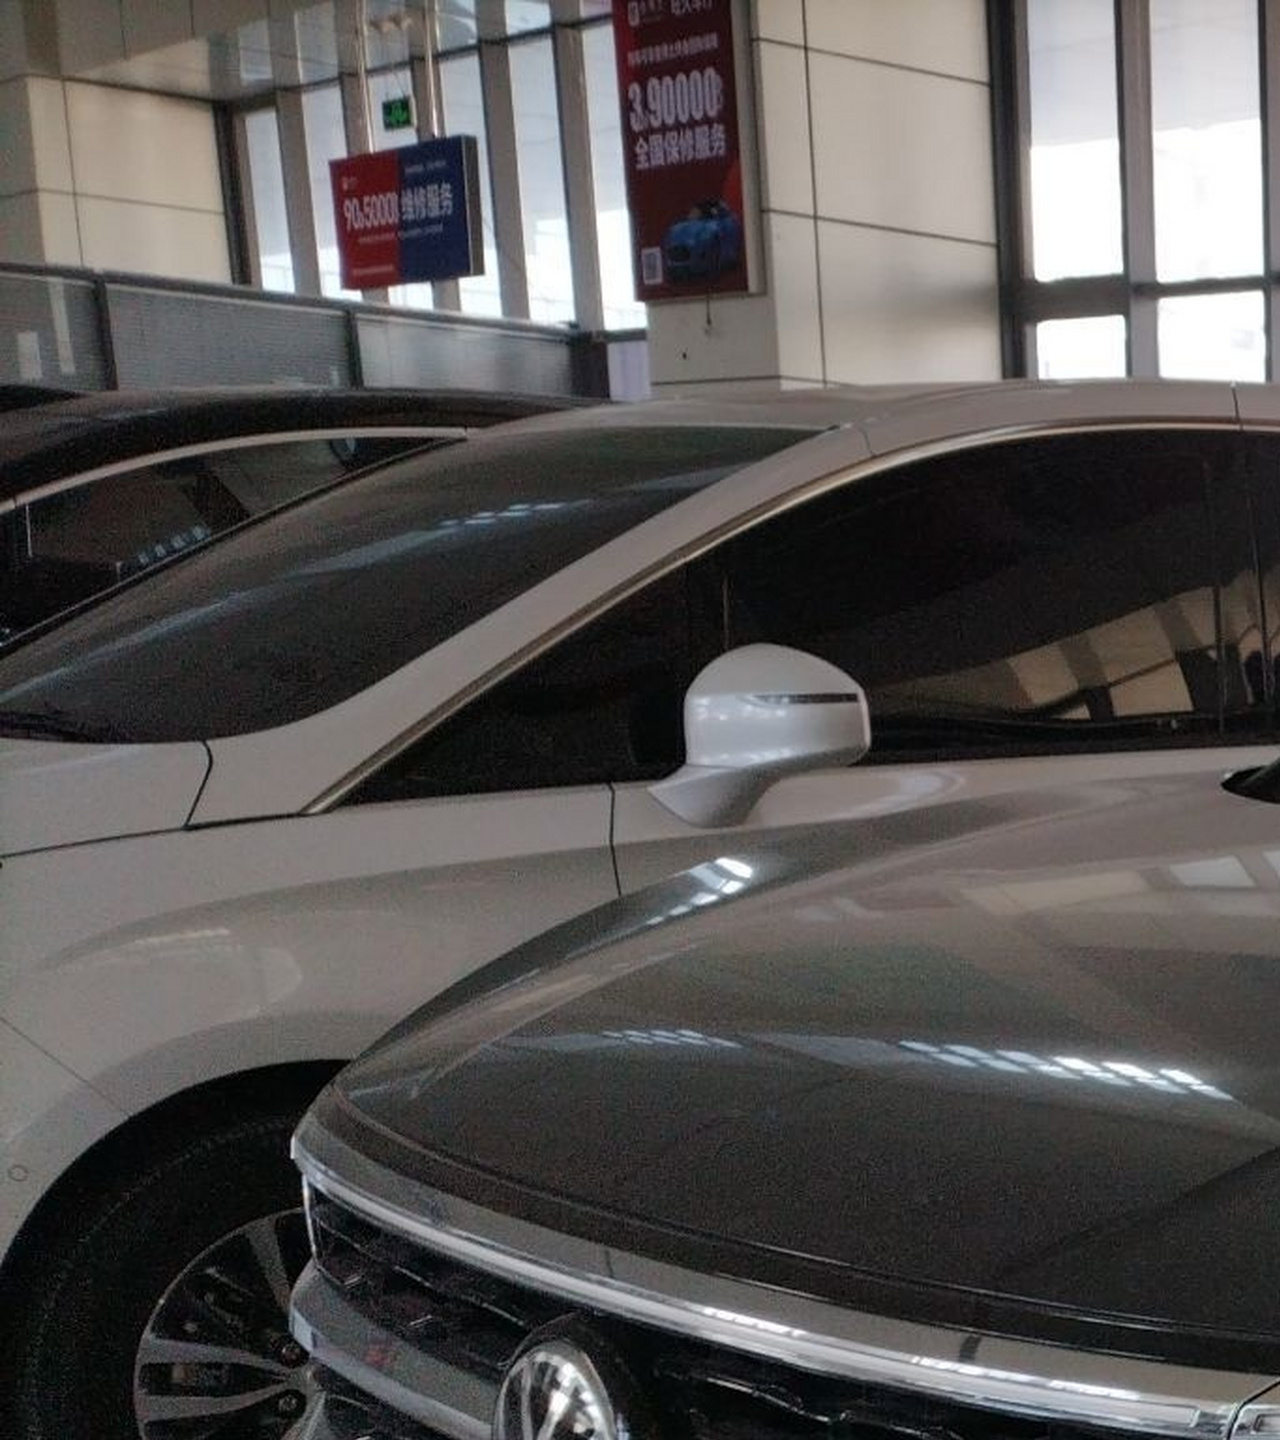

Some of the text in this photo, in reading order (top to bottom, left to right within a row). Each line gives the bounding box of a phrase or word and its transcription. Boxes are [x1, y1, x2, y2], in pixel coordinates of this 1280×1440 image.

[635, 122, 726, 171] 全国保修服务
